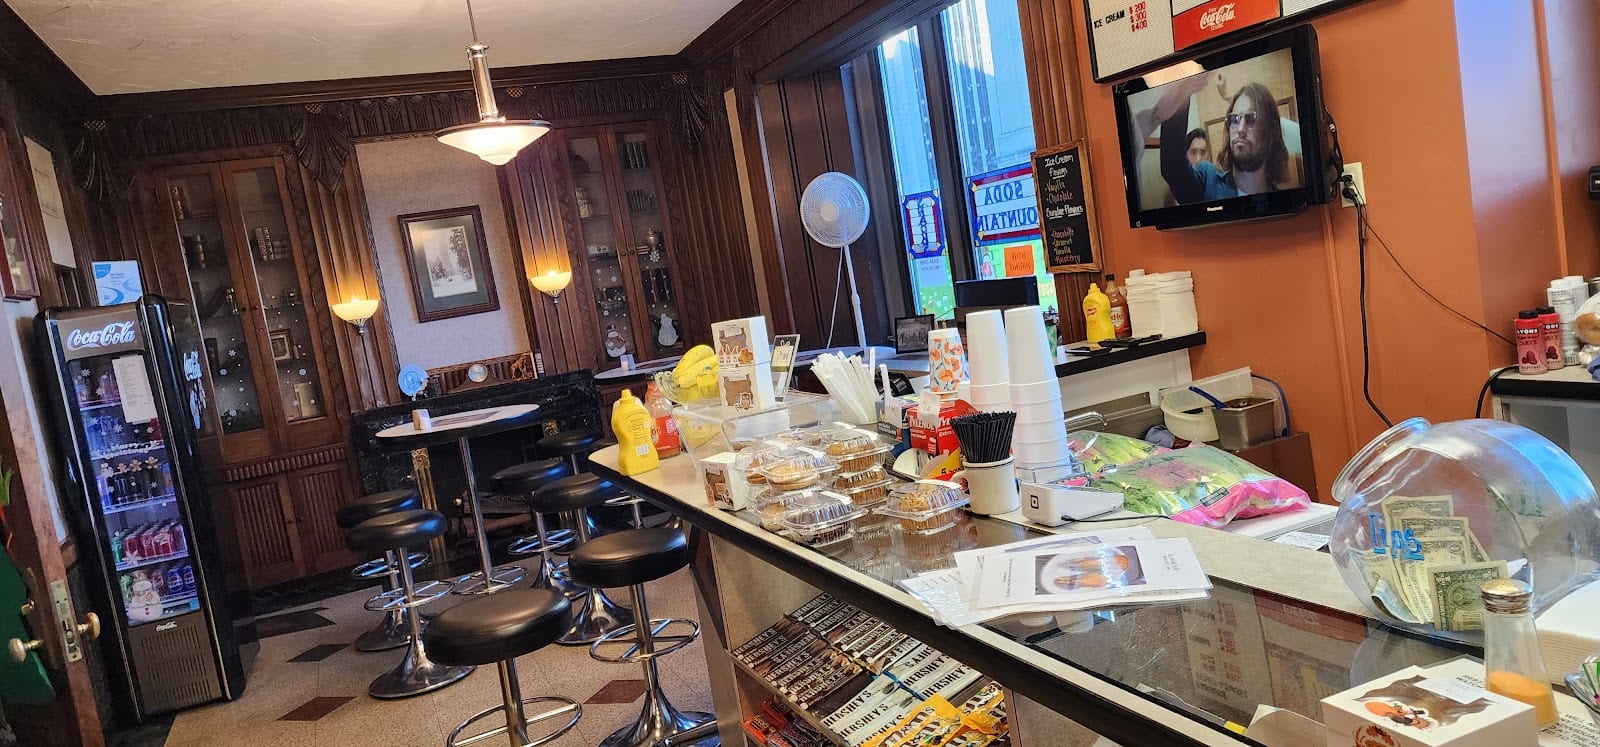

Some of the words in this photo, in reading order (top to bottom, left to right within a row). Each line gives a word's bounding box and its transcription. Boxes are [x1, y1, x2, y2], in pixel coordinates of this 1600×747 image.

[1094, 18, 1103, 29] ICE
[1105, 9, 1126, 24] CREAM
[1368, 513, 1424, 560] Tips
